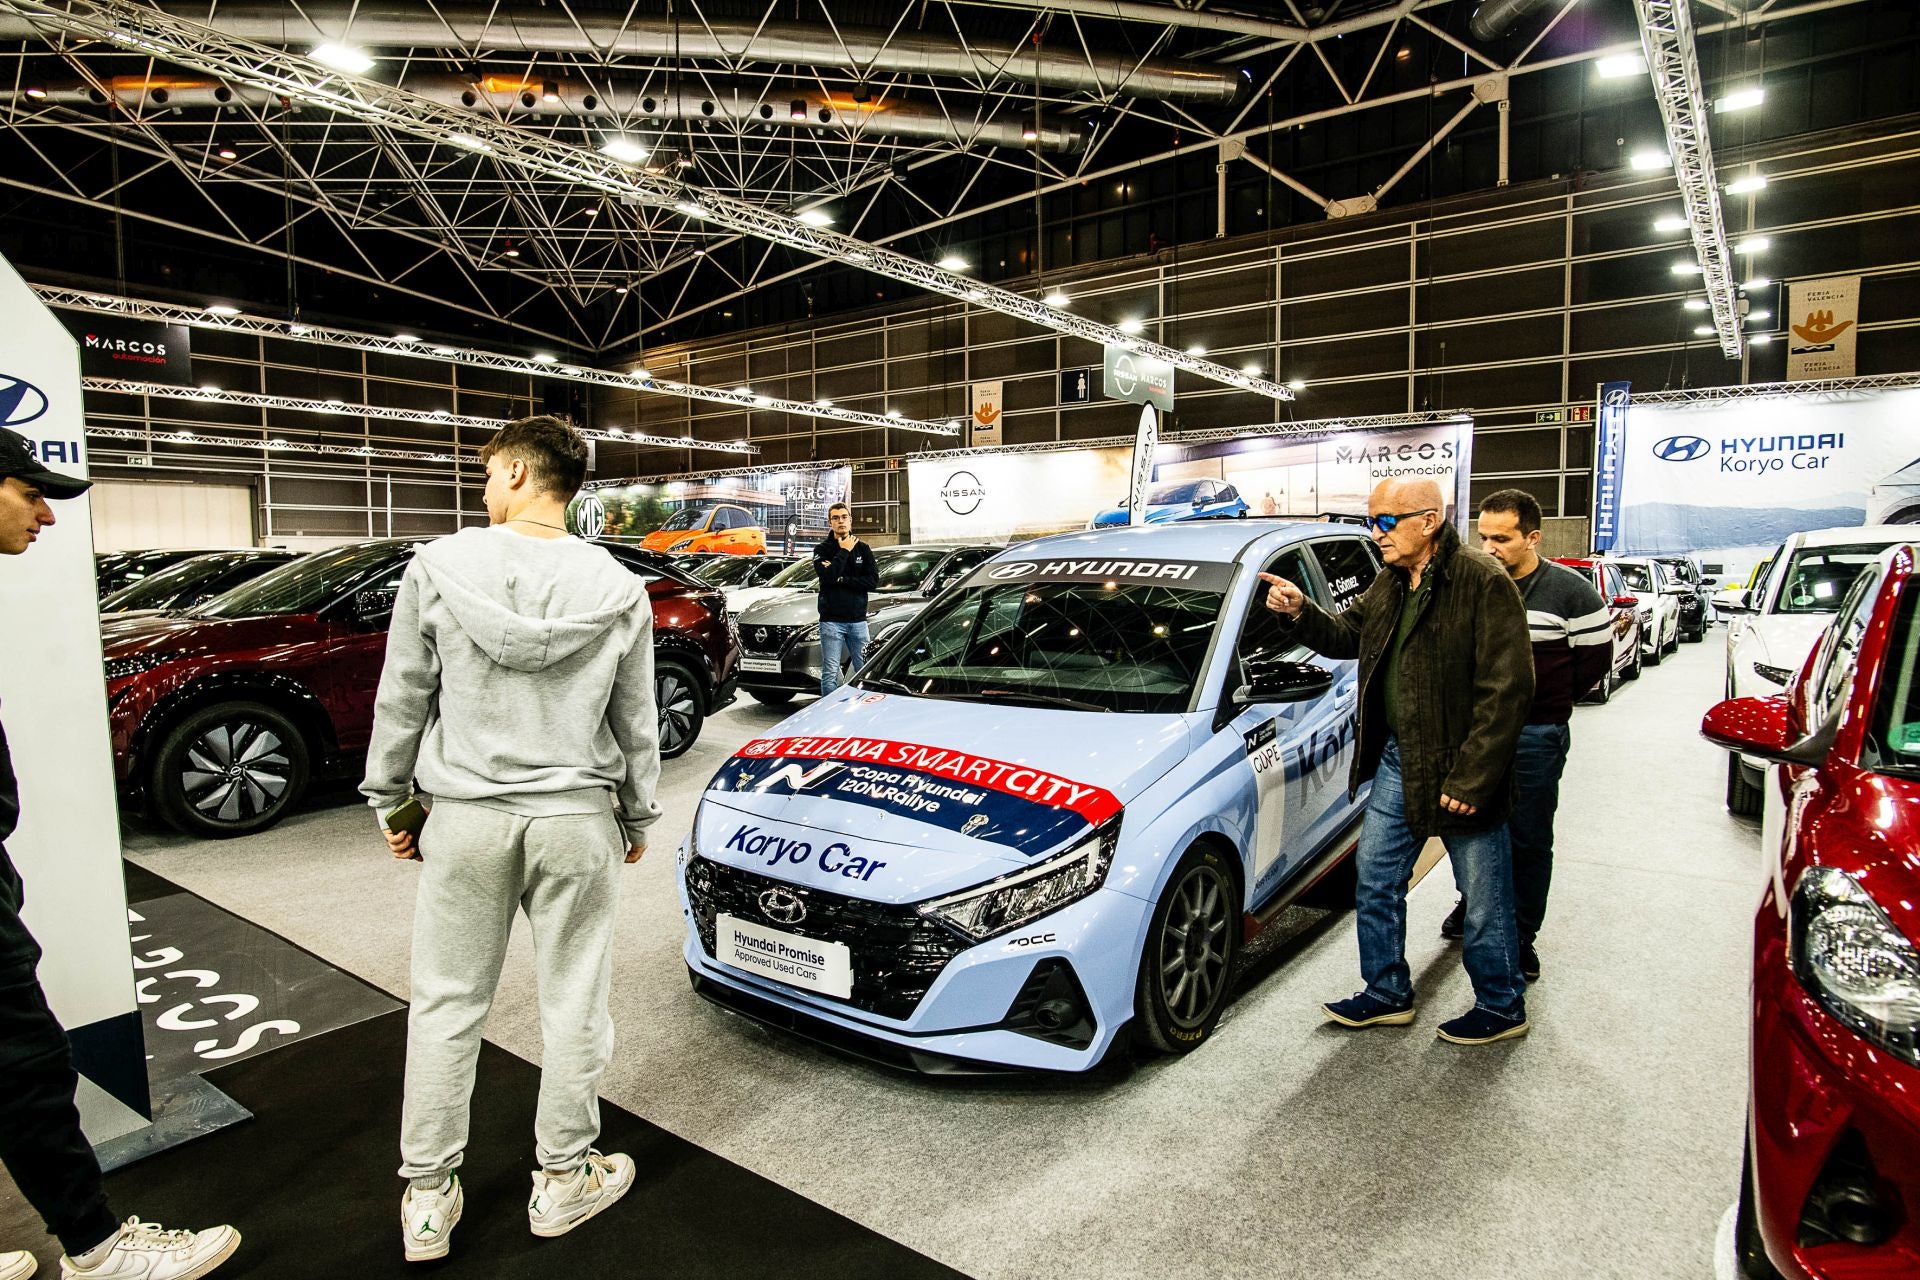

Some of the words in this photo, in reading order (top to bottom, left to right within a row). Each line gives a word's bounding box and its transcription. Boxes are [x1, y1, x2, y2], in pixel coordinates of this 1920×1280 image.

[1807, 294, 1845, 302] VALENCIA
[85, 334, 167, 356] MARCOS
[112, 353, 167, 364] automoción
[1804, 365, 1842, 373] VALENCIA
[1336, 441, 1454, 464] MARCOS
[1721, 432, 1844, 454] HYUNDAI
[1133, 423, 1153, 512] NISSAN
[1371, 464, 1453, 478] automoción
[1720, 456, 1784, 475] Koryo
[1791, 453, 1830, 470] Car
[786, 485, 846, 501] MARCOS
[940, 488, 986, 498] NISSAN
[1039, 561, 1199, 580] HYUNDAI
[1335, 575, 1360, 594] Gómez
[852, 766, 896, 784] Copa
[902, 774, 988, 806] Hyundai
[887, 745, 1096, 806] SMARTCITY
[882, 787, 941, 813] Rallye
[725, 824, 812, 866] Koryo
[818, 842, 888, 882] Car
[734, 930, 776, 954] Hyundai
[778, 943, 825, 966] Promise
[734, 948, 771, 968] Approved
[773, 960, 795, 975] Used
[796, 966, 817, 981] Cars
